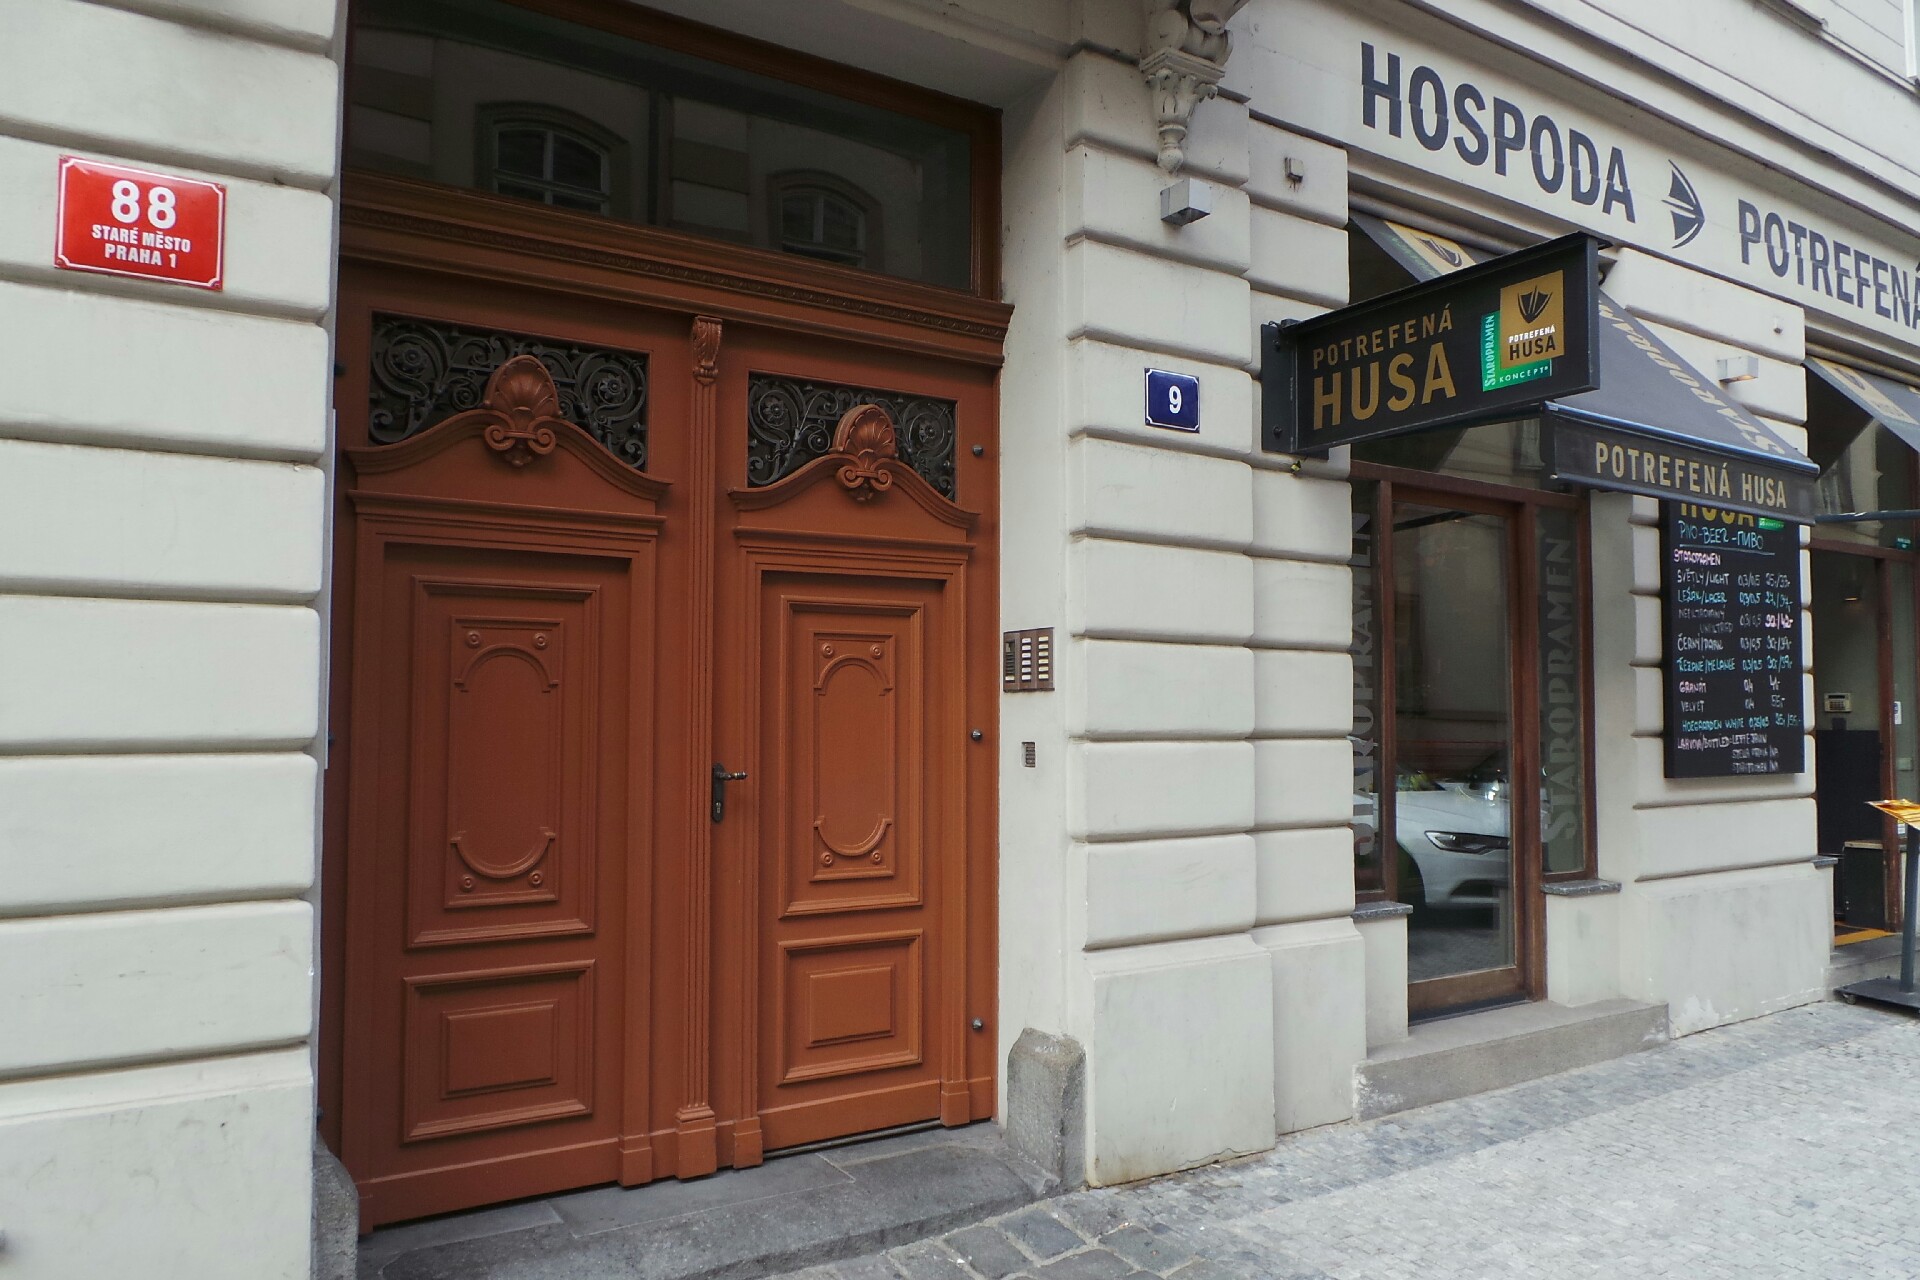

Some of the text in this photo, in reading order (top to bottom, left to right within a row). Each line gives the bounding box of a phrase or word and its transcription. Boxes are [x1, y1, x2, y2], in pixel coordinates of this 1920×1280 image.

[1361, 41, 1636, 223] HOSPODA
[111, 180, 176, 229] 88
[92, 224, 191, 253] STARÉ MĚSTO
[105, 243, 177, 268] PRAHA 1
[1313, 303, 1453, 370] POTREFENÁ
[1485, 315, 1496, 387] STAROPRAMEN
[1508, 324, 1556, 343] POTREFENÁ
[1509, 335, 1556, 361] HUSA
[1168, 385, 1182, 414] 9
[1313, 342, 1456, 430] HUSA
[1596, 442, 1787, 509] POTREFENÁ HUSA
[1547, 538, 1578, 841] STAROPRAMEN
